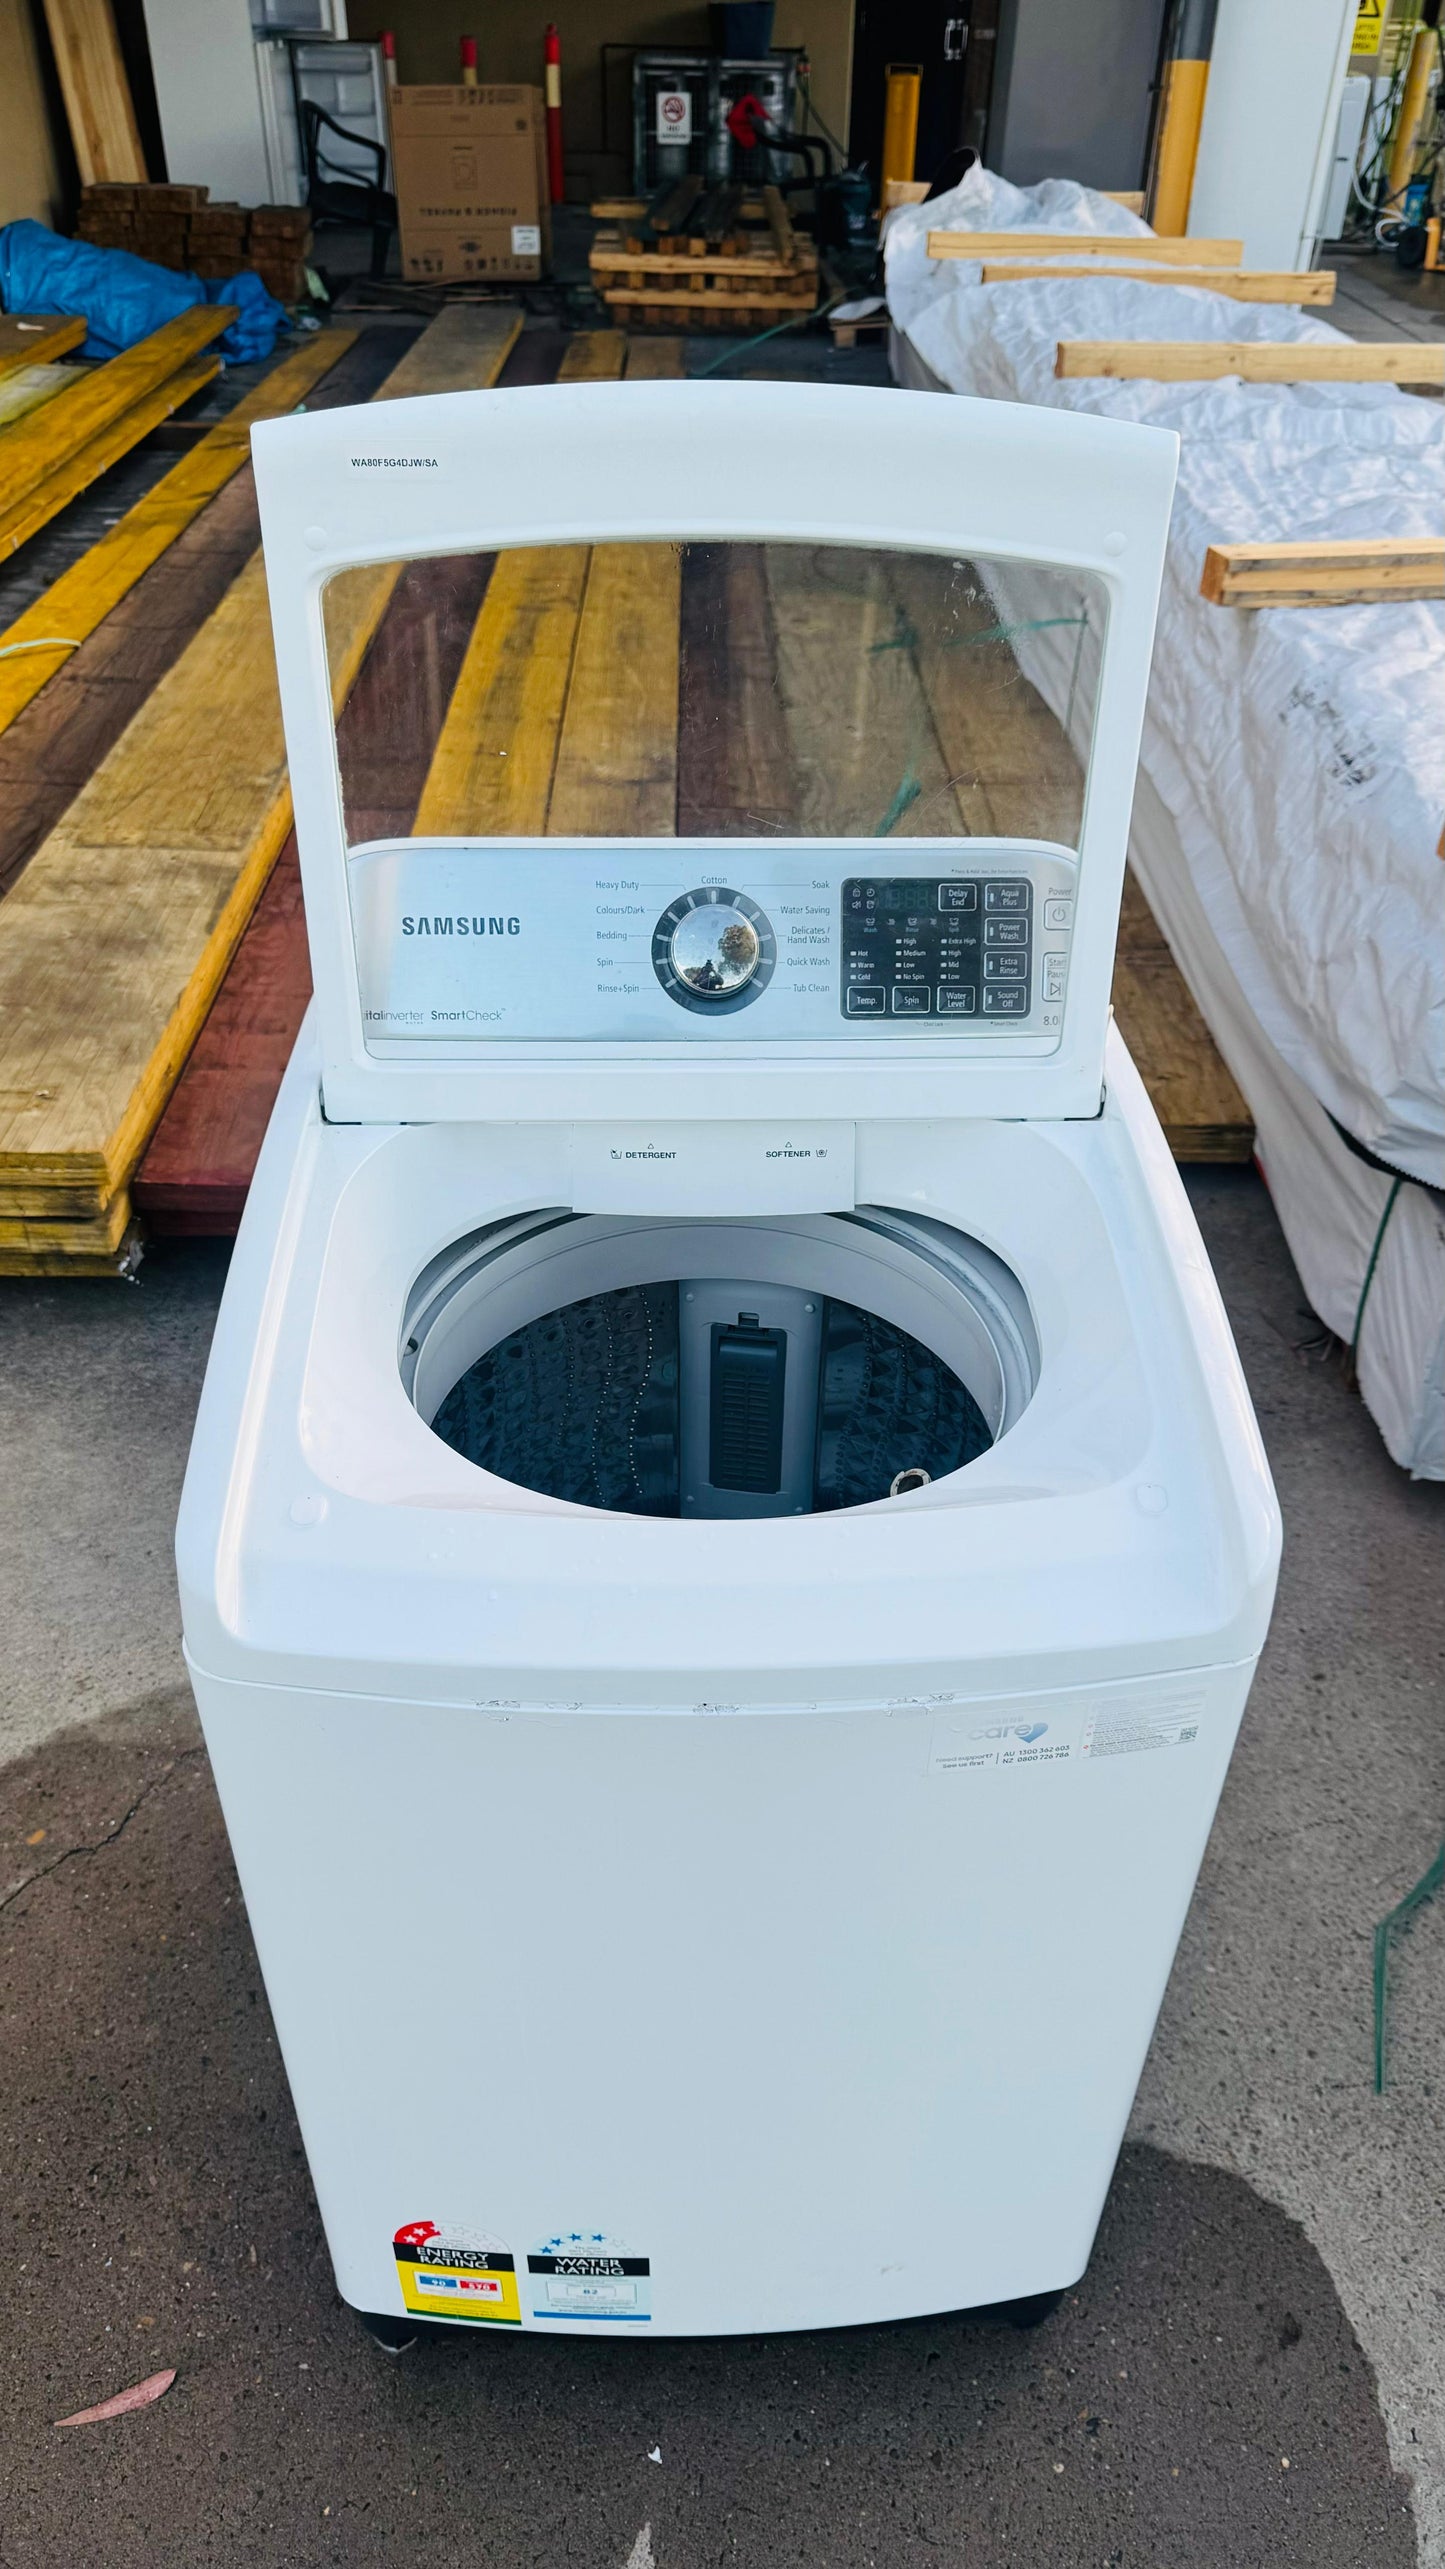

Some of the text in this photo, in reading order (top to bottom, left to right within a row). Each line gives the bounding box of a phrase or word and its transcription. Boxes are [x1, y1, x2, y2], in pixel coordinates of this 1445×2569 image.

[351, 458, 438, 467] WA80F5G4DJW/SA
[701, 876, 728, 884] Cotton
[812, 880, 830, 889] Soak
[595, 881, 639, 891] Heavy Duty
[948, 889, 968, 898] Delay
[1000, 889, 1019, 898] Aqua
[1048, 887, 1072, 895] Power
[951, 898, 965, 906] End
[1002, 898, 1017, 906] Plus
[596, 906, 645, 915] Colours/Dark
[780, 906, 830, 916] Water Saving
[402, 917, 520, 936] SAMSUNG
[791, 926, 825, 934] Delicates
[596, 931, 627, 941] Bedding
[787, 936, 830, 944] Hand Wash
[1000, 932, 1019, 940] Wash
[597, 958, 613, 968] Spin
[787, 957, 830, 966] Quick Wash
[1000, 966, 1018, 974] Rinse
[598, 984, 639, 994] Rinse+Spin
[793, 984, 830, 992] Tub Clean
[997, 991, 1018, 999] Sound
[857, 996, 877, 1005] Temp.
[904, 996, 919, 1005] Spin
[363, 1010, 424, 1021] italinverter
[1043, 1016, 1060, 1025] 8.0
[766, 1150, 811, 1158] SOFTENER
[968, 1724, 1032, 1740] care
[417, 2246, 488, 2261] ENERGY
[421, 2255, 489, 2270] RATING
[556, 2257, 621, 2268] WATER
[555, 2265, 624, 2276] RATING
